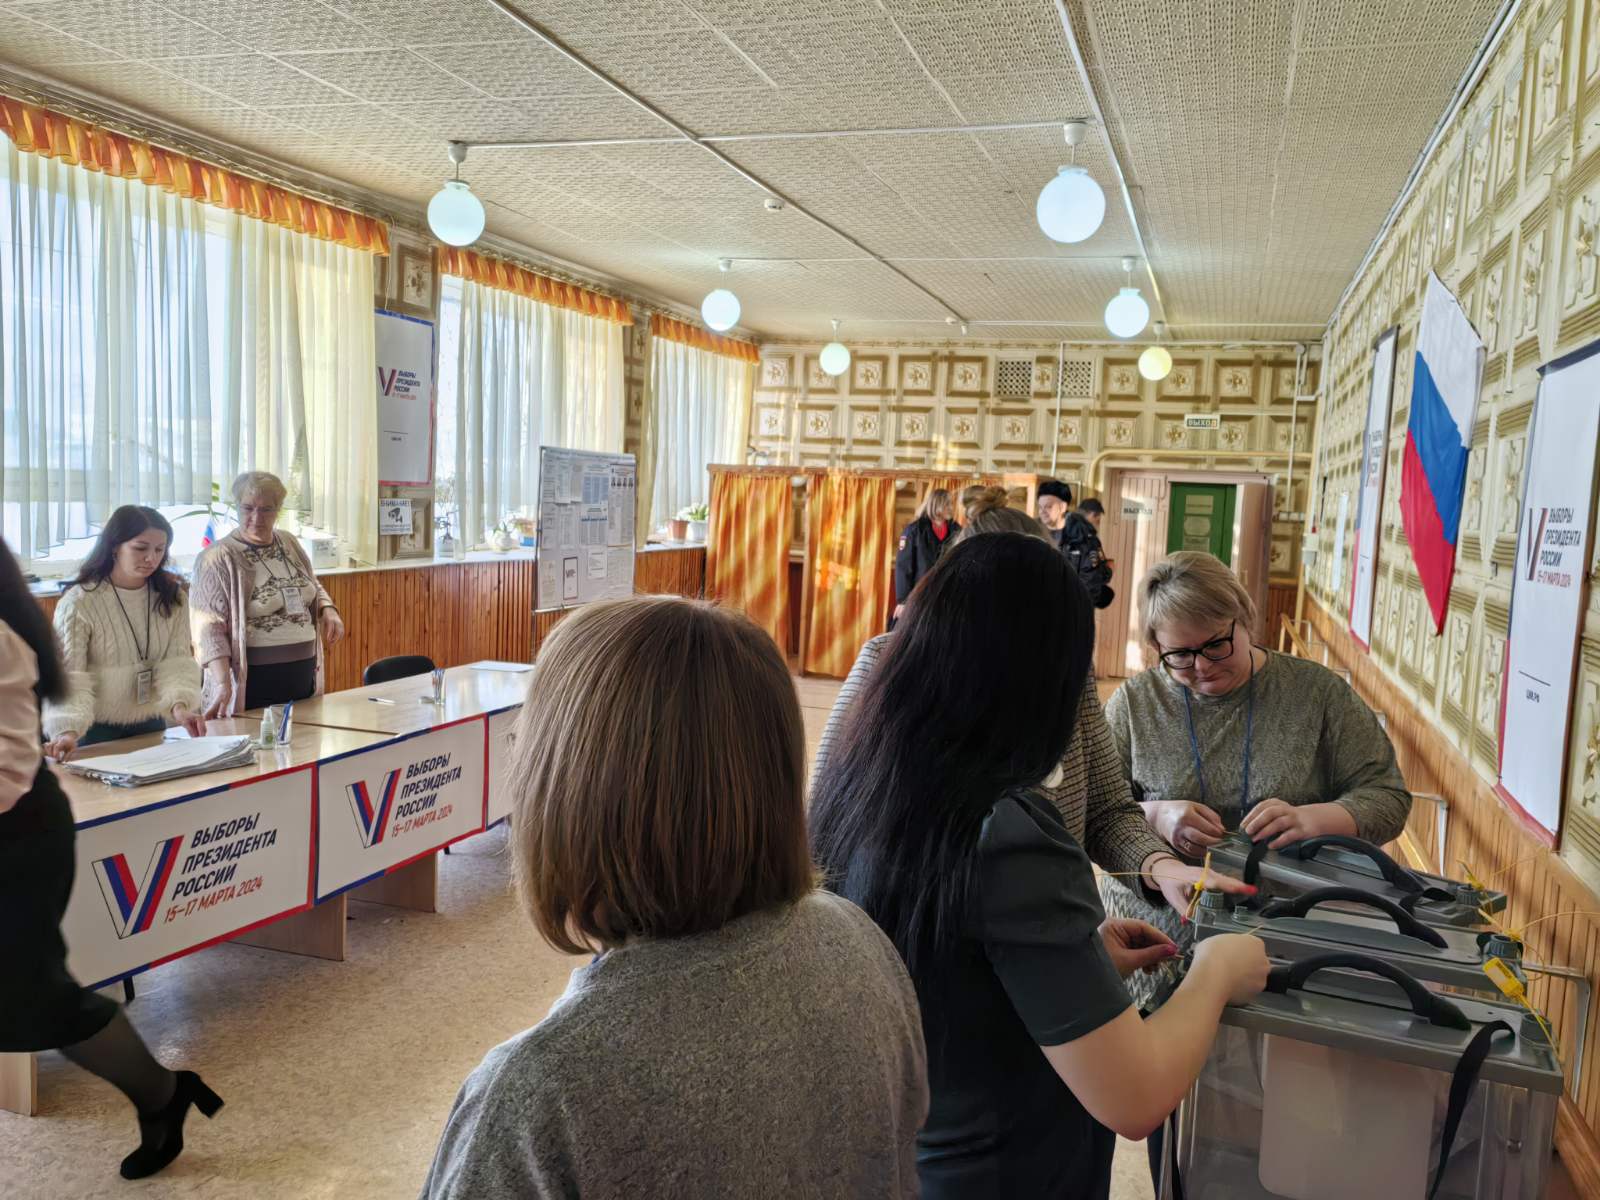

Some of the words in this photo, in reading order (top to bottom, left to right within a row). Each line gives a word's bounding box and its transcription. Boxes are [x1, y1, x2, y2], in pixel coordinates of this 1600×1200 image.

[1188, 418, 1217, 428] ВЫХОД
[1548, 507, 1575, 524] ВЫБОРЫ
[1544, 529, 1582, 547] ПРЕЗИДЕНТА
[1540, 550, 1563, 567] РОССИИ
[405, 752, 451, 779] ВЫБОРЫ
[400, 766, 462, 799] ПРЕЗИДЕНТА
[395, 793, 438, 820] РОССИИ
[411, 810, 437, 829] МАРТА
[437, 804, 453, 820] 2024
[190, 812, 261, 849] ВЫБОРЫ
[181, 829, 278, 875] ПРЕЗИДЕНТА
[171, 863, 238, 901] РОССИИ
[198, 883, 236, 912] МАРТА
[236, 875, 264, 898] 2024
